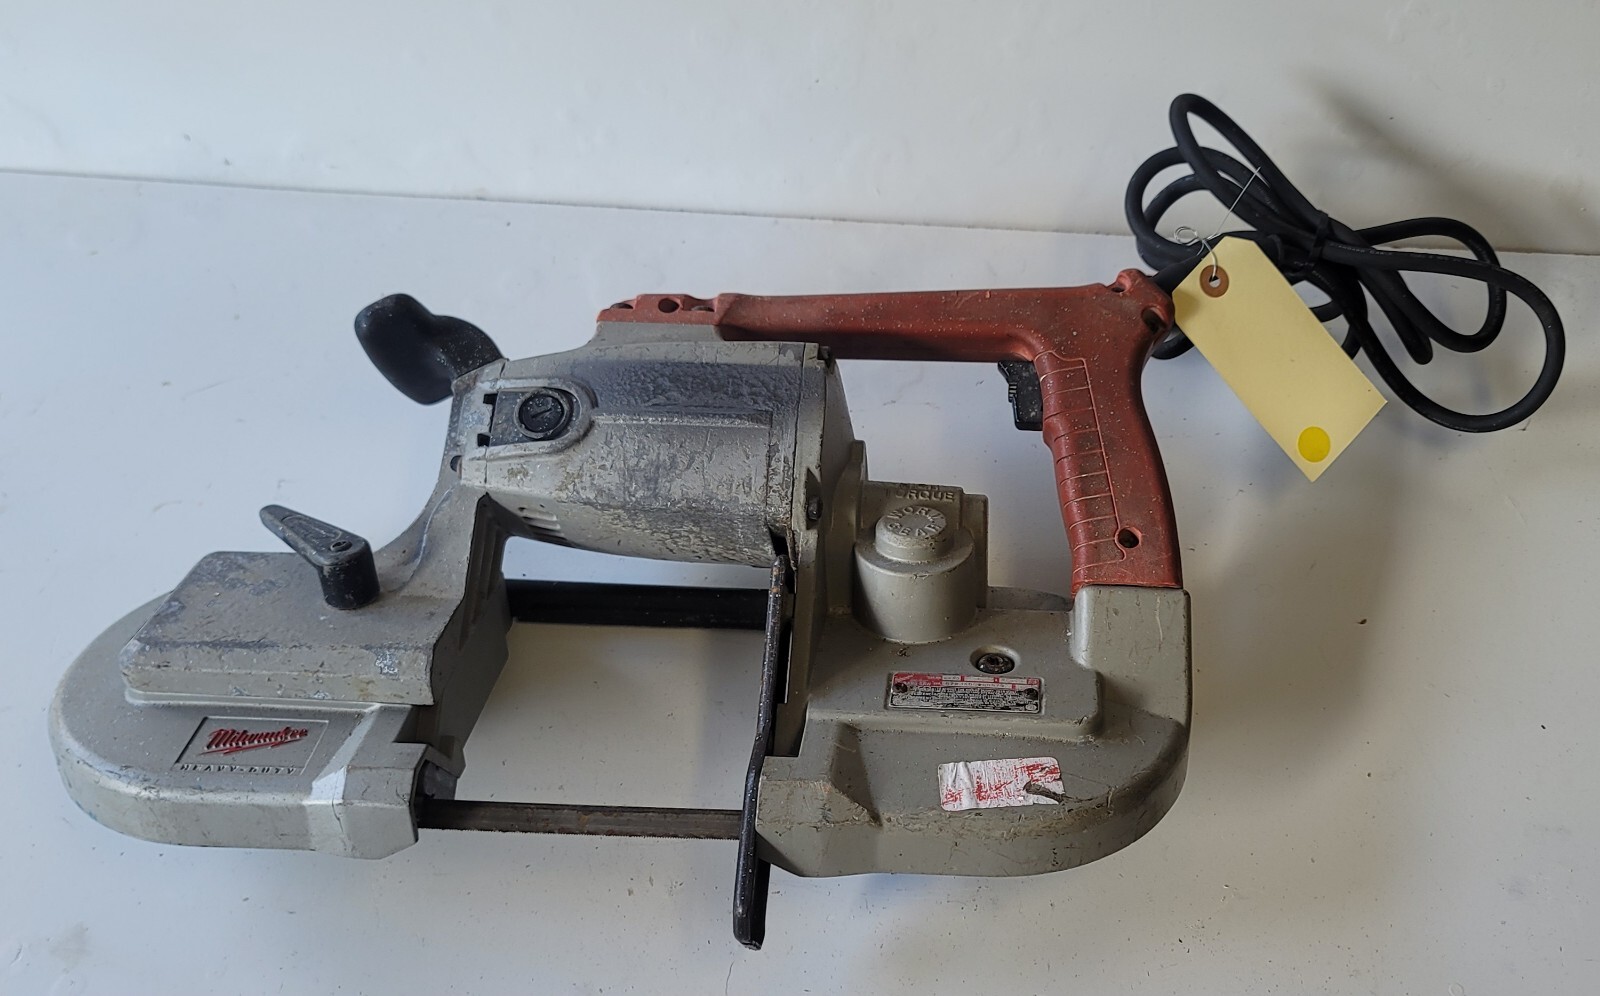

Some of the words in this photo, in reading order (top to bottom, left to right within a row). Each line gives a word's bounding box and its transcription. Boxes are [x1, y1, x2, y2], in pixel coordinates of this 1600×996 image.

[887, 522, 942, 537] GEAR
[205, 727, 309, 751] Milwaukee
[180, 764, 297, 775] HEAVY-DUTY
